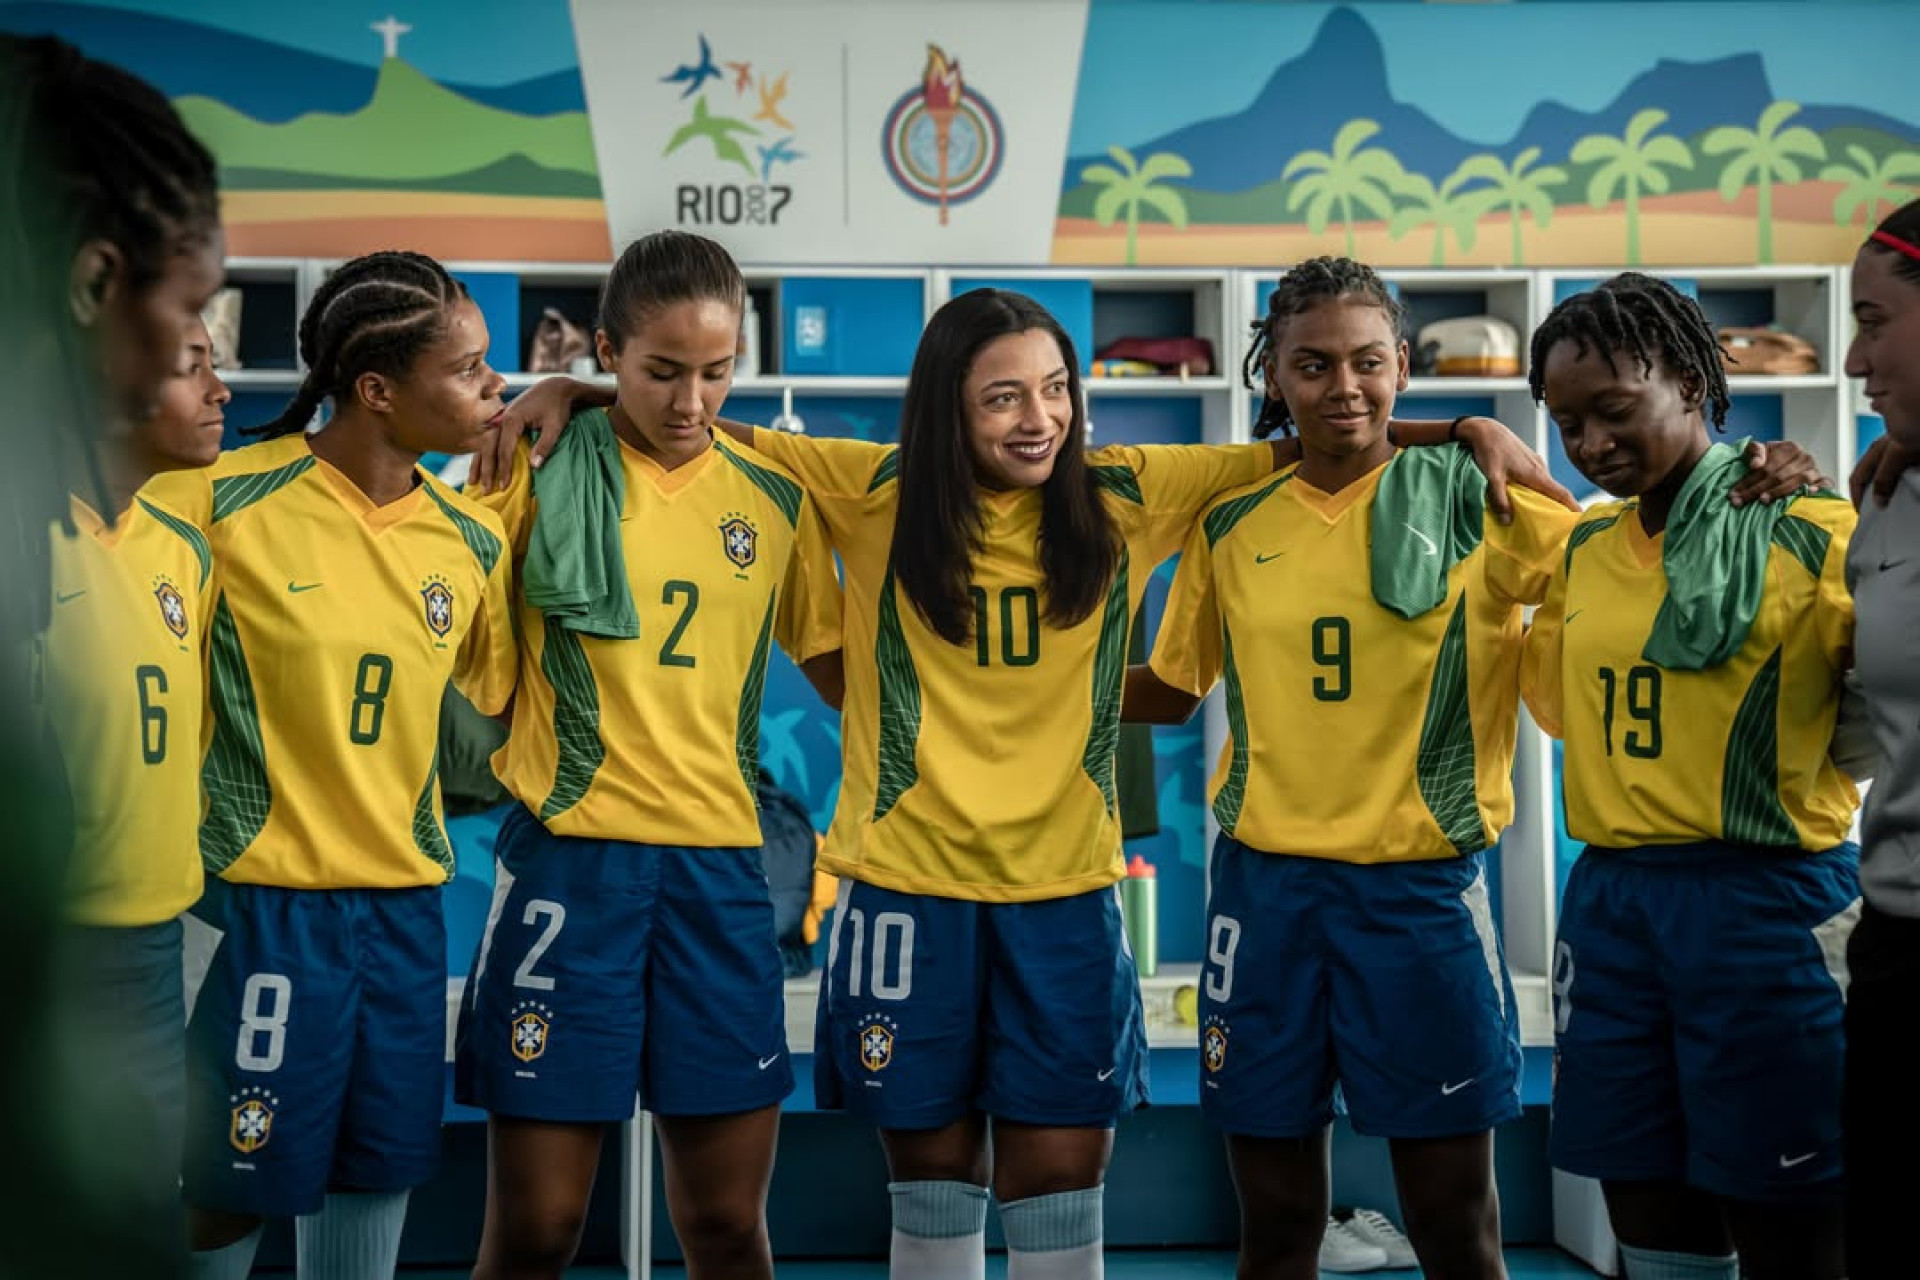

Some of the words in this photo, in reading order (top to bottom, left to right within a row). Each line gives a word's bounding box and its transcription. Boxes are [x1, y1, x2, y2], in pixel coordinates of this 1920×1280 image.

[676, 184, 742, 225] RIO
[658, 579, 700, 669] 2
[966, 586, 1040, 668] 10
[1311, 616, 1352, 703] 9
[136, 664, 169, 766] 6
[349, 653, 394, 746] 8
[1598, 665, 1663, 760] 19
[513, 899, 567, 991] 2
[849, 908, 915, 1000] 10
[1206, 914, 1242, 1004] 9
[235, 973, 293, 1073] 8
